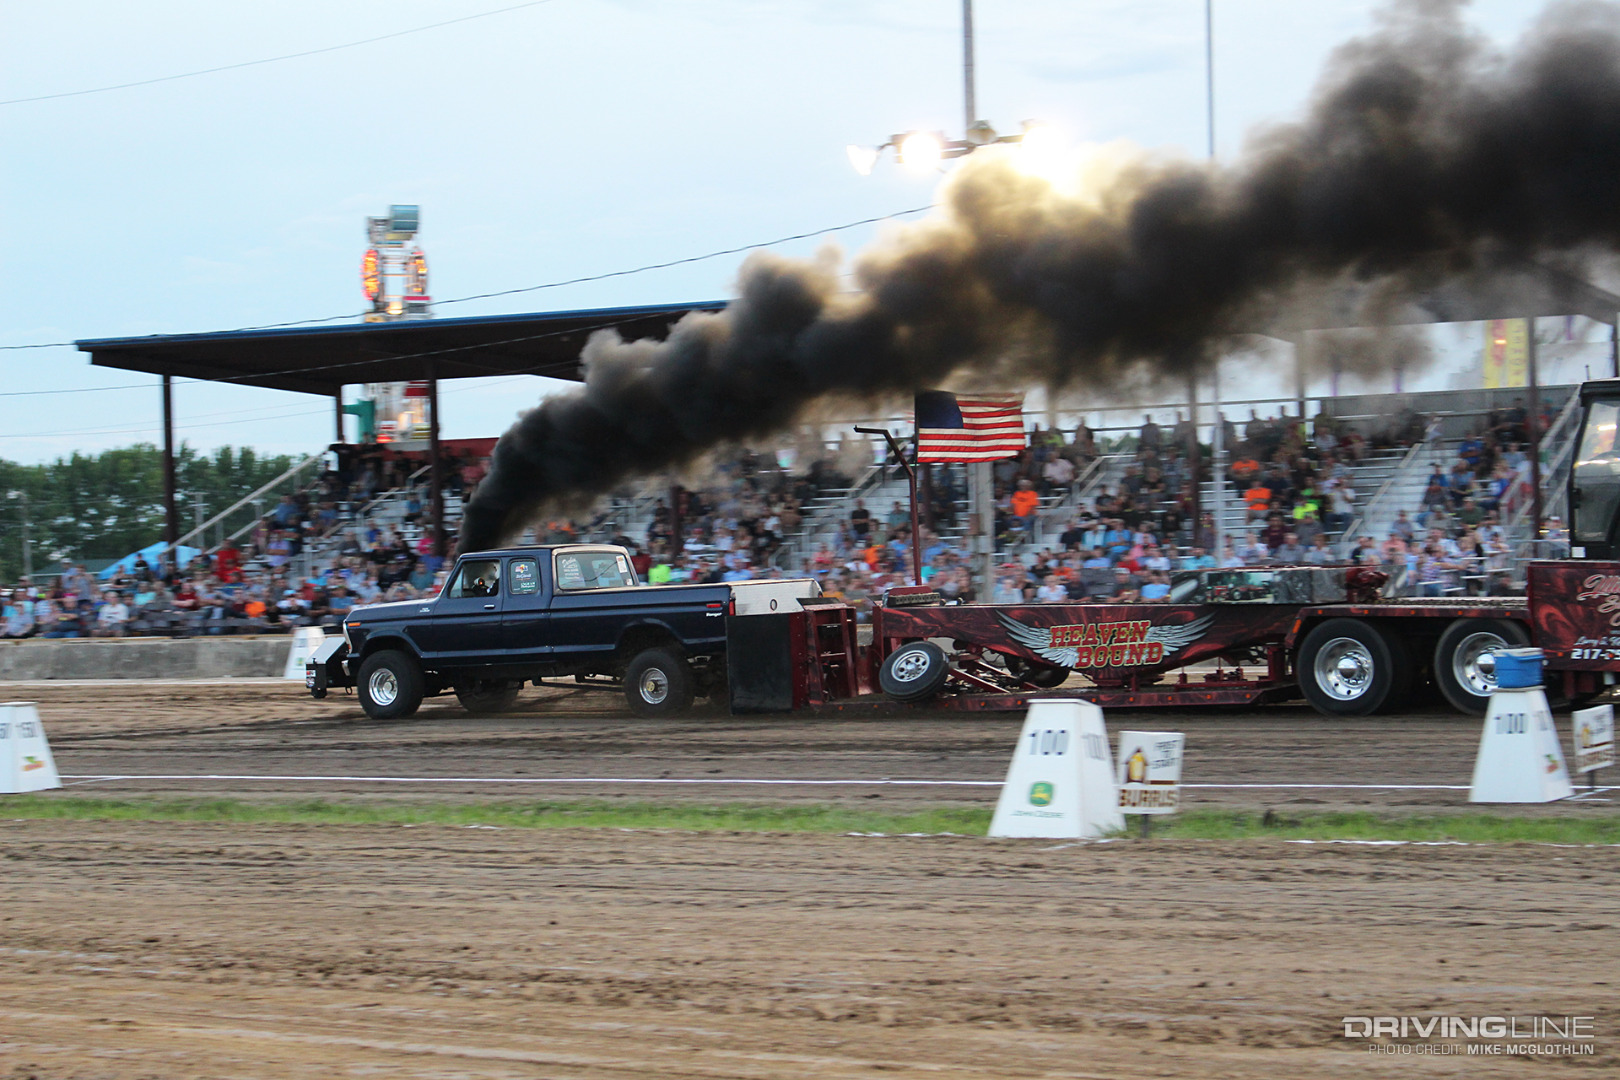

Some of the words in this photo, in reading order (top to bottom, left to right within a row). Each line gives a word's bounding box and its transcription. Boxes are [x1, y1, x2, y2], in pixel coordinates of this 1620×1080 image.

[1048, 620, 1151, 649] HEAVEN
[1073, 641, 1163, 669] BOUND
[1028, 729, 1070, 755] 100
